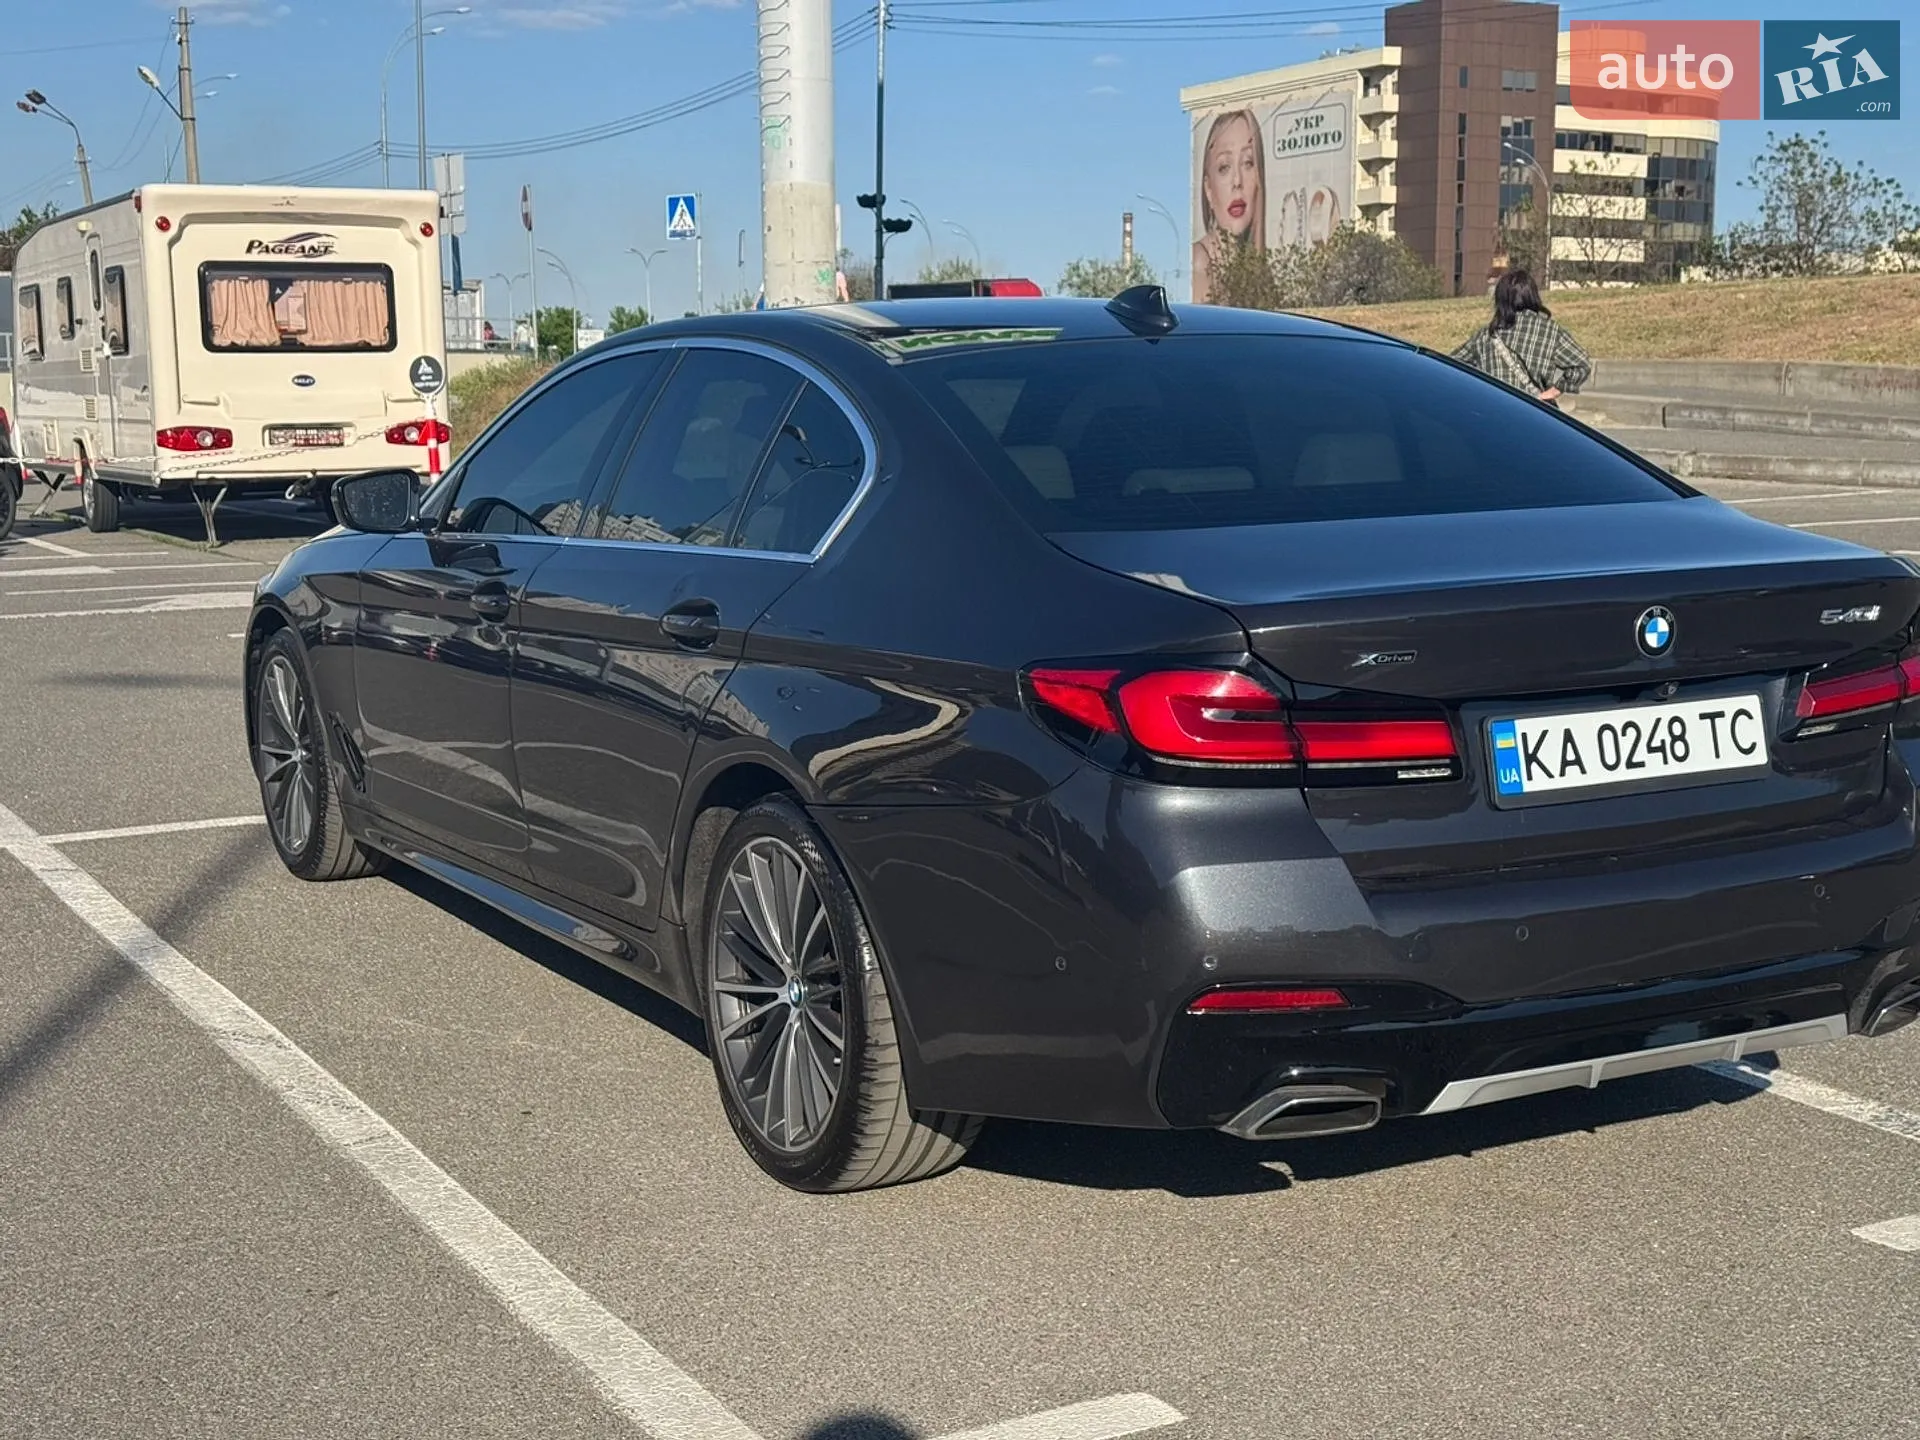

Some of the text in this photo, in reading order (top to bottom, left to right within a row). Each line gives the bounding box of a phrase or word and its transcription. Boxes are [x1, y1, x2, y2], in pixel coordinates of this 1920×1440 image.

[1277, 130, 1342, 152] ЗОЛОТО
[245, 239, 335, 254] PAGEANT
[1521, 708, 1757, 781] KA 0248 TC
[1500, 769, 1520, 784] UA
